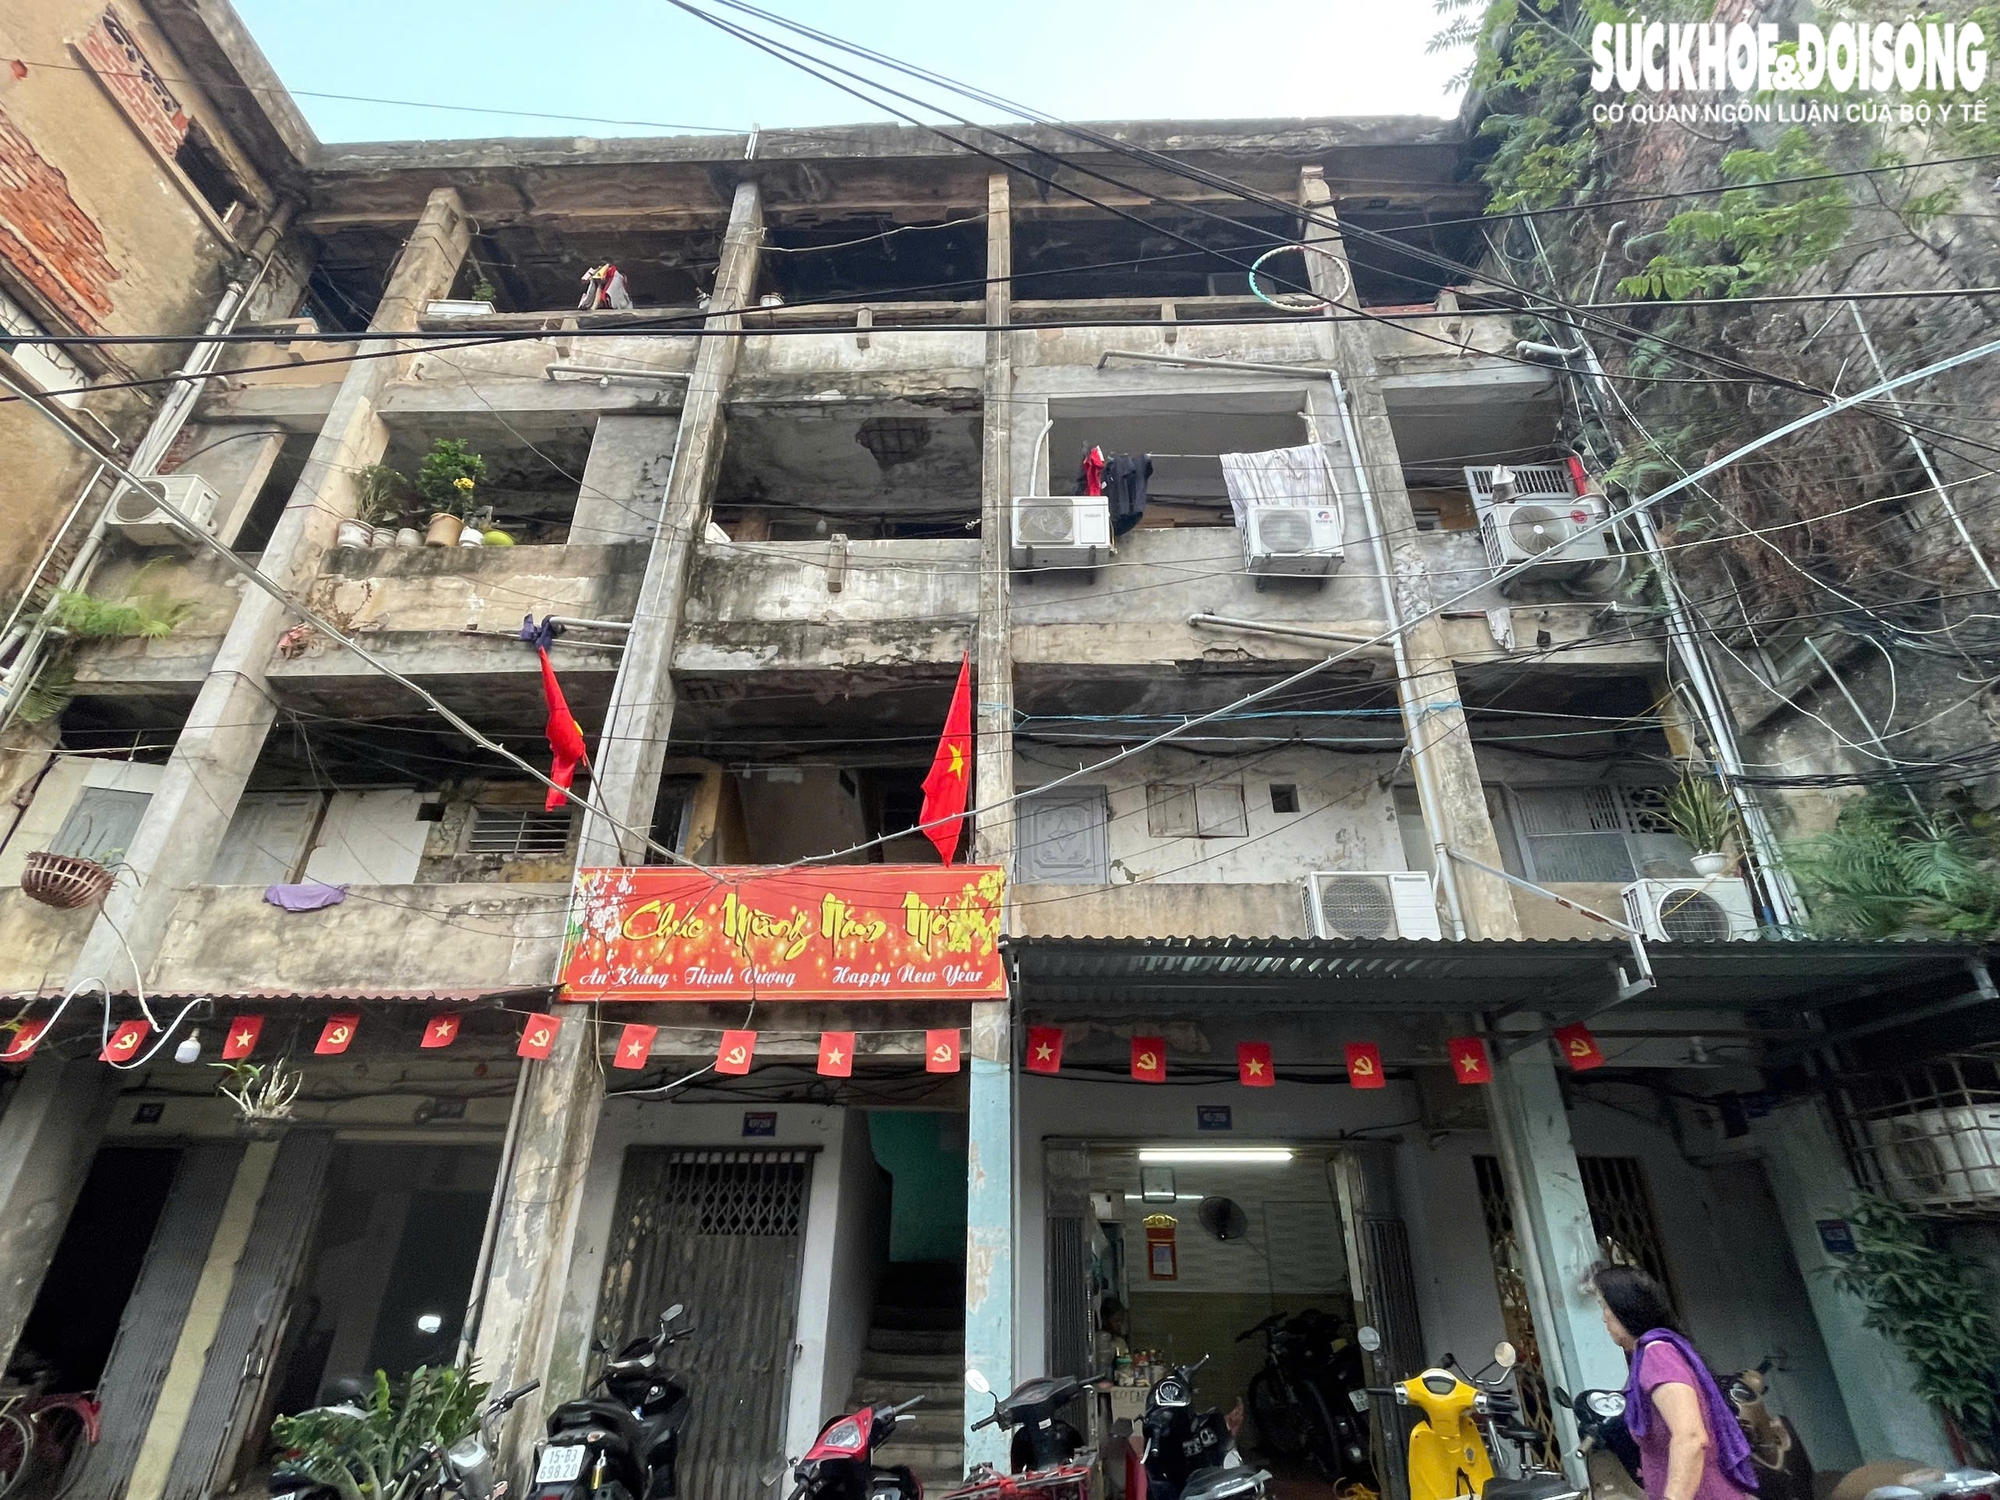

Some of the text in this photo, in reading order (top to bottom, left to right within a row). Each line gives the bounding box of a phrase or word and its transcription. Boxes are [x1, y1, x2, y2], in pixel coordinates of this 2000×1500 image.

[621, 899, 704, 941] Chúc
[719, 892, 816, 962] Mừng
[820, 892, 887, 961] Năm
[579, 965, 797, 989] An Khang Thịnh Vượng
[832, 964, 984, 988] Happy New Year
